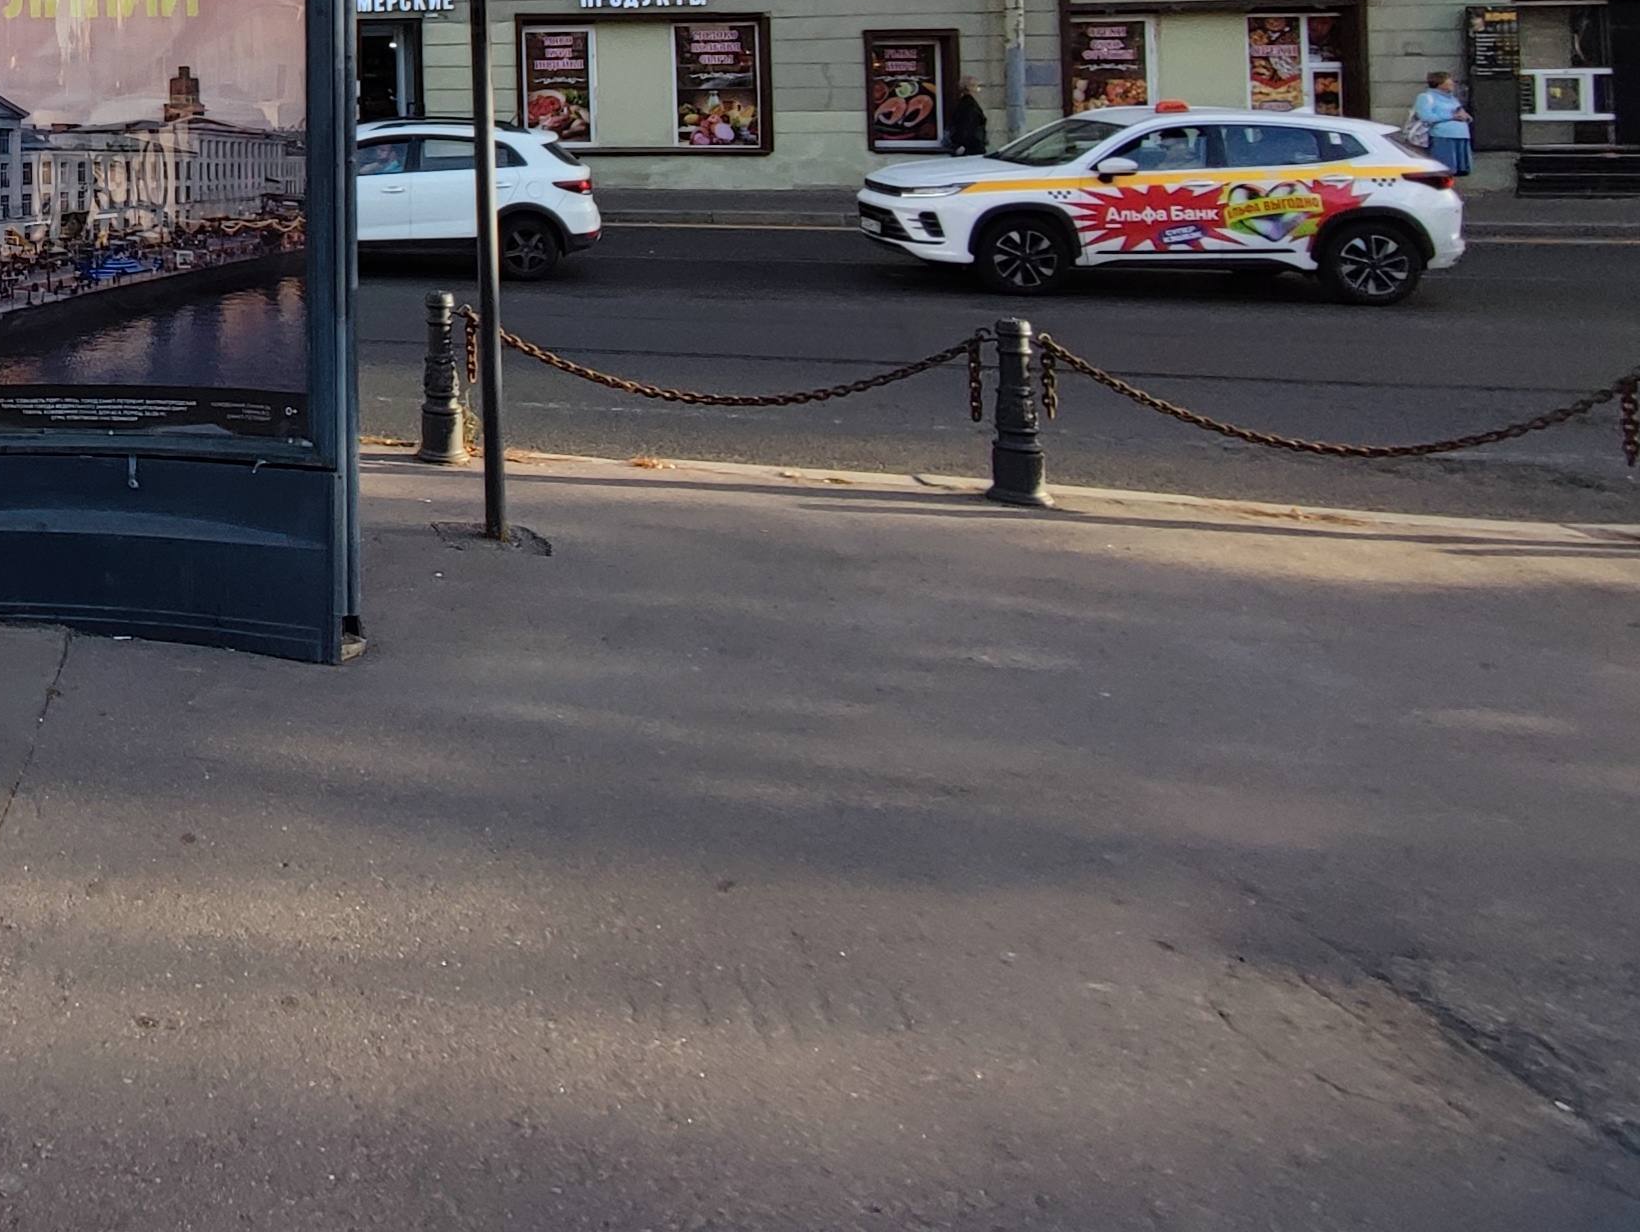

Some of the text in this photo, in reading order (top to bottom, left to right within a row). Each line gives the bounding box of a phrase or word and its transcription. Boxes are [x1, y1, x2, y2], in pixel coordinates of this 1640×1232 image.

[1105, 205, 1219, 226] Альфа Банк
[285, 406, 299, 416] 0+
